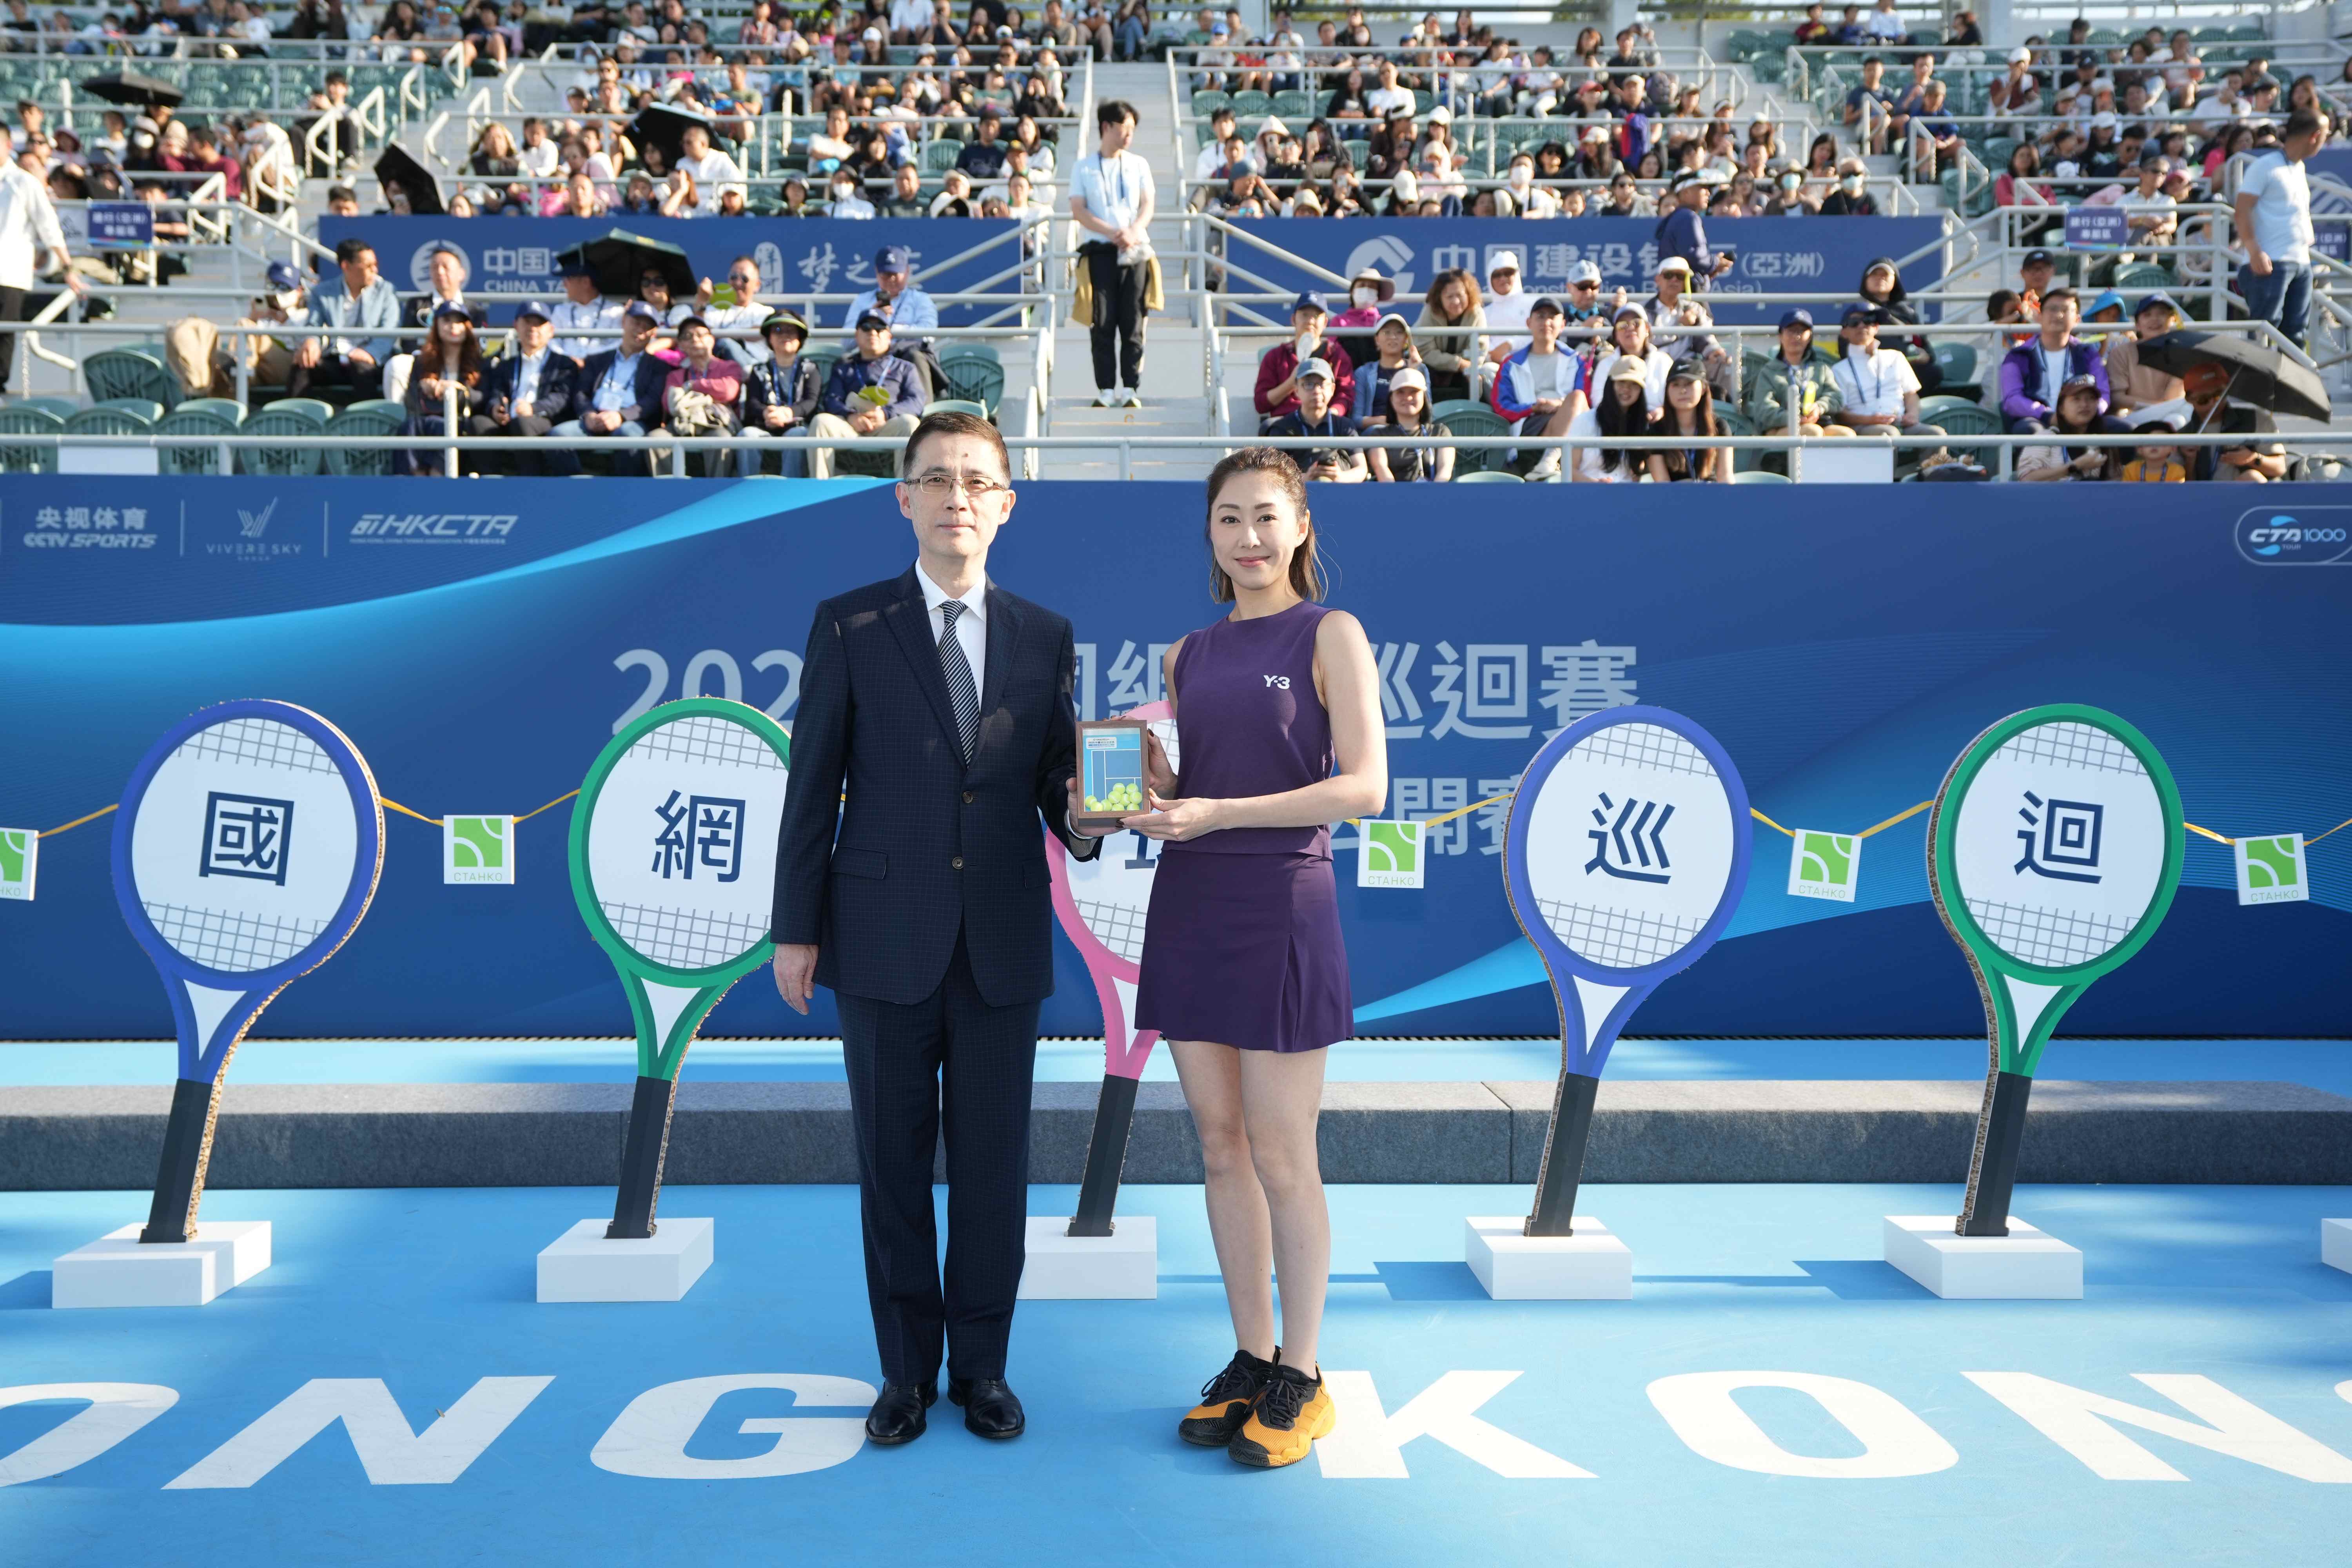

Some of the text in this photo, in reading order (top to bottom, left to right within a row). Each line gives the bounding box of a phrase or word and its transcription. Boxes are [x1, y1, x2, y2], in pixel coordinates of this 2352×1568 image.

[484, 279, 567, 292] CHINA TA
[36, 506, 147, 530] 央视体育
[23, 532, 158, 548] CCTV SPORTS
[2302, 528, 2347, 542] 1000
[271, 543, 301, 555] SKY
[1263, 675, 1290, 689] Y-3
[612, 649, 804, 739] 202
[199, 791, 294, 887] 國
[651, 789, 746, 882] 網
[1584, 791, 1676, 884] 巡
[2014, 790, 2104, 884] 迴
[454, 872, 503, 881] CTAHKO
[1368, 876, 1414, 886] CTAHKO
[1799, 885, 1846, 898] CTAHKO
[2250, 890, 2299, 902] CTAHKO
[1314, 1370, 2352, 1483] KON
